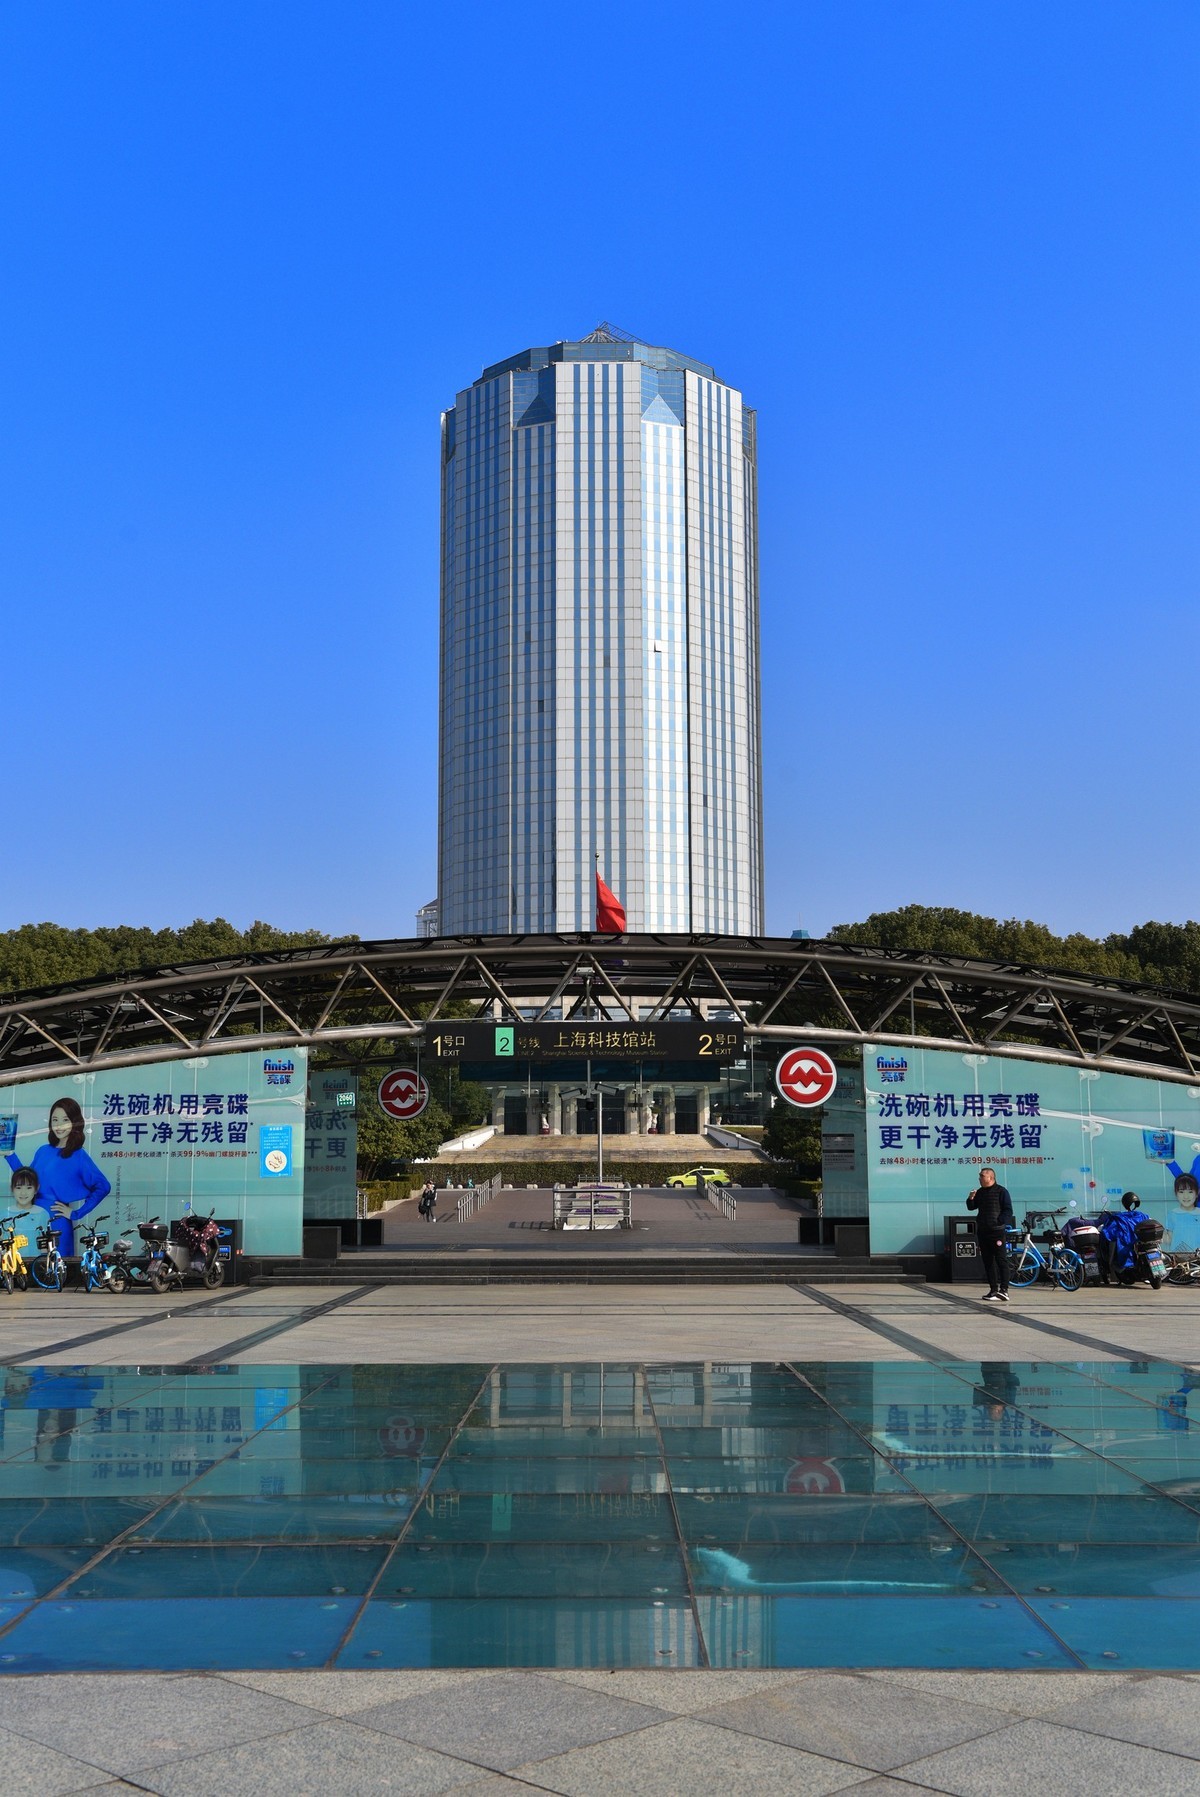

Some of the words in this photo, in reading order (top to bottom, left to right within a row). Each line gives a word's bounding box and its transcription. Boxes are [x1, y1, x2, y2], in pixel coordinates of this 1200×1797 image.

[553, 1031, 656, 1048] 上海科技馆站
[263, 1058, 295, 1071] finish
[876, 1056, 908, 1069] finish
[102, 1093, 249, 1116] 洗碗机用亮碟
[878, 1092, 1042, 1118] 洗碗机用亮碟
